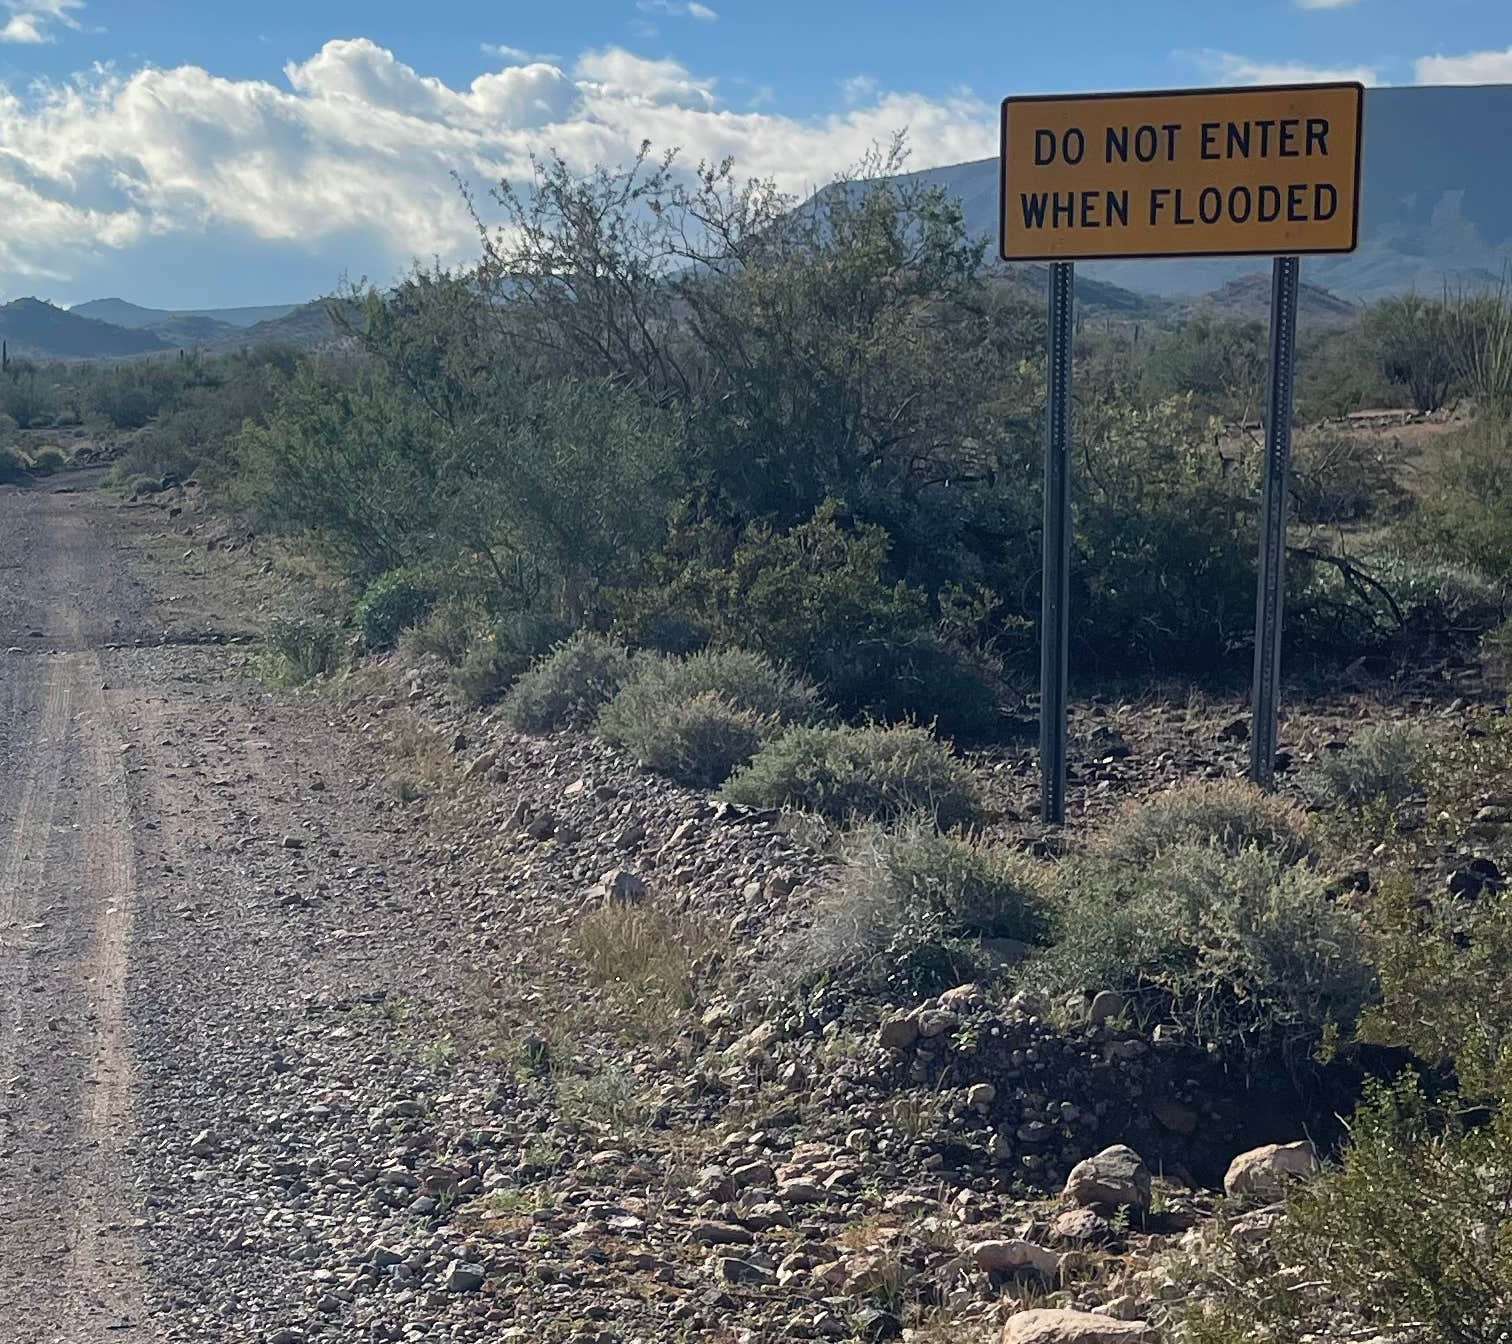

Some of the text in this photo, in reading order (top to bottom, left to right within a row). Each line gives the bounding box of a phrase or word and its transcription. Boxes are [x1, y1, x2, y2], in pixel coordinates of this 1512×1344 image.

[1034, 118, 1330, 166] DO NOT ENTER
[1020, 183, 1338, 229] WHEN FLOODED
